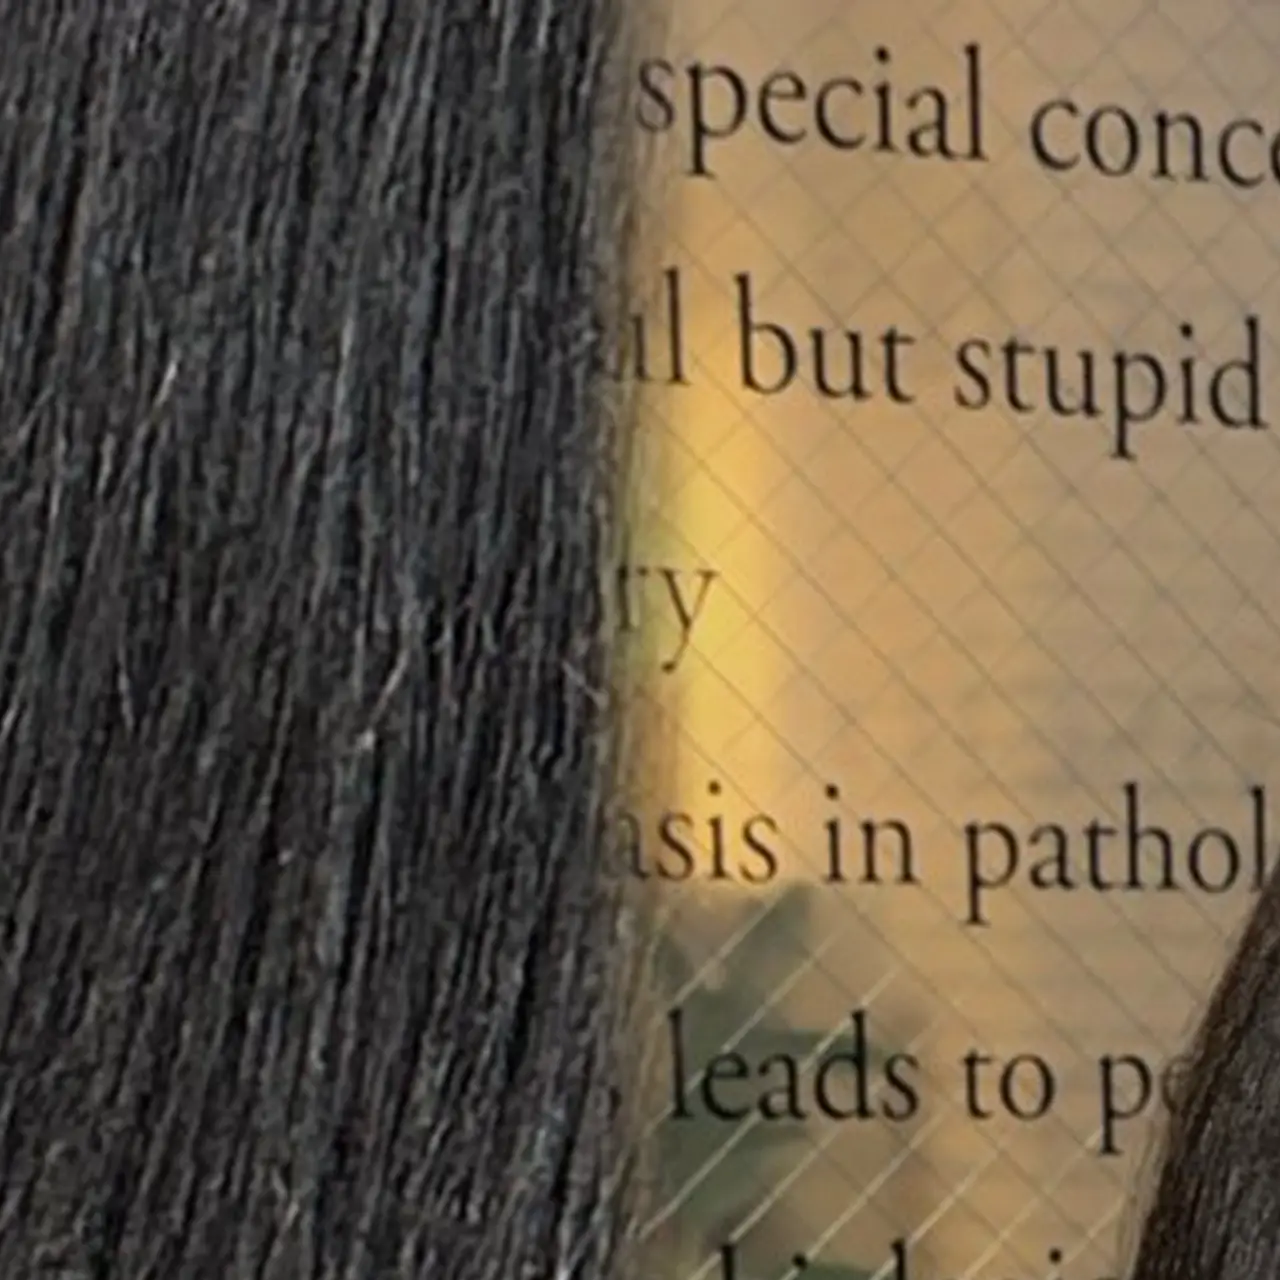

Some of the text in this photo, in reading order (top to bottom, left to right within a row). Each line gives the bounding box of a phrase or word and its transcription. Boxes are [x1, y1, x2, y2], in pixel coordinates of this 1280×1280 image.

[635, 42, 988, 180] special
[732, 270, 917, 405] but
[953, 316, 1269, 461] stupid
[824, 783, 920, 887] in
[963, 780, 1266, 926] pathol
[667, 1006, 920, 1122] leads
[961, 1049, 1057, 1121] to
